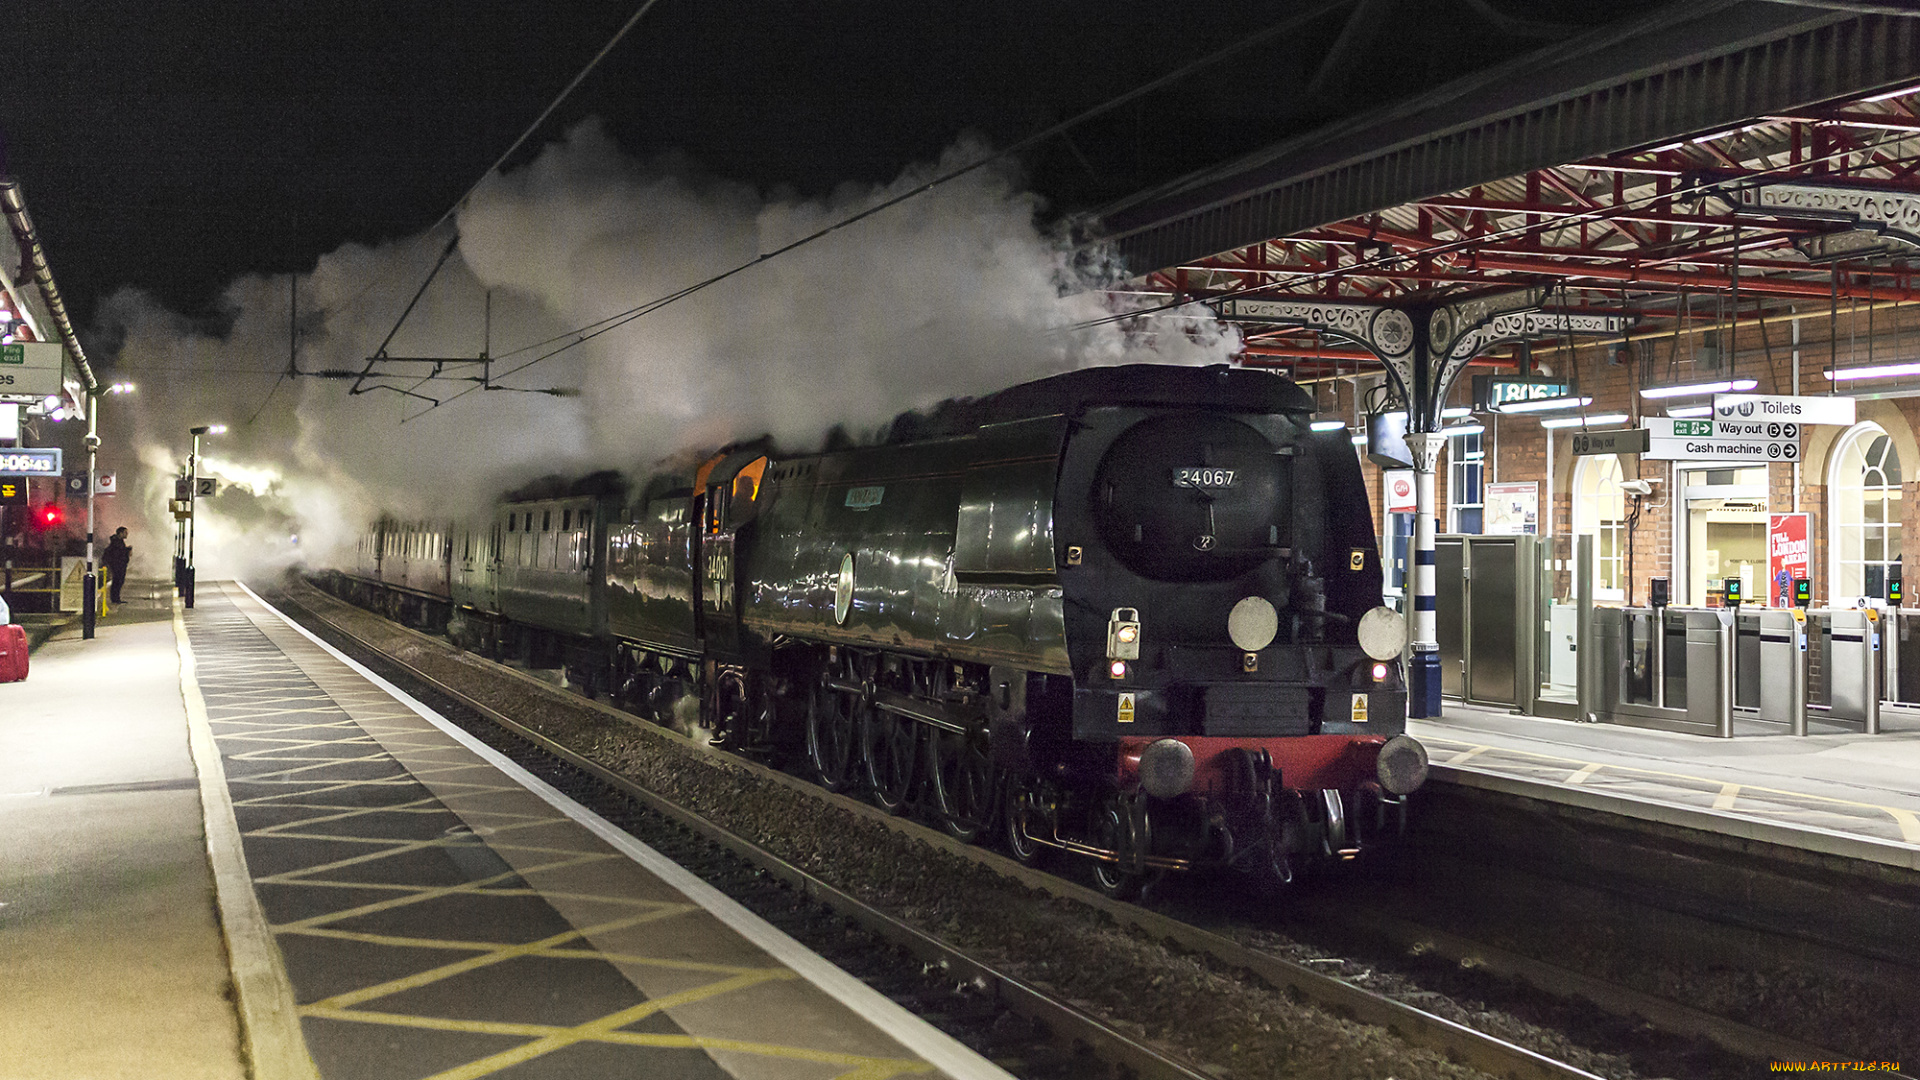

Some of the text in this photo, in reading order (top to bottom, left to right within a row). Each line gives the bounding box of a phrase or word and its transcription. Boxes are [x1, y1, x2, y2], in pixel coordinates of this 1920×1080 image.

[1760, 401, 1802, 415] Toilets
[1675, 421, 1688, 429] Fire
[1719, 423, 1763, 436] Way out
[1604, 437, 1615, 447] out
[1686, 442, 1763, 454] Cash machine
[1181, 470, 1235, 485] 34067
[201, 481, 211, 494] 2
[1771, 531, 1789, 544] FULL
[1772, 539, 1807, 557] LONDON
